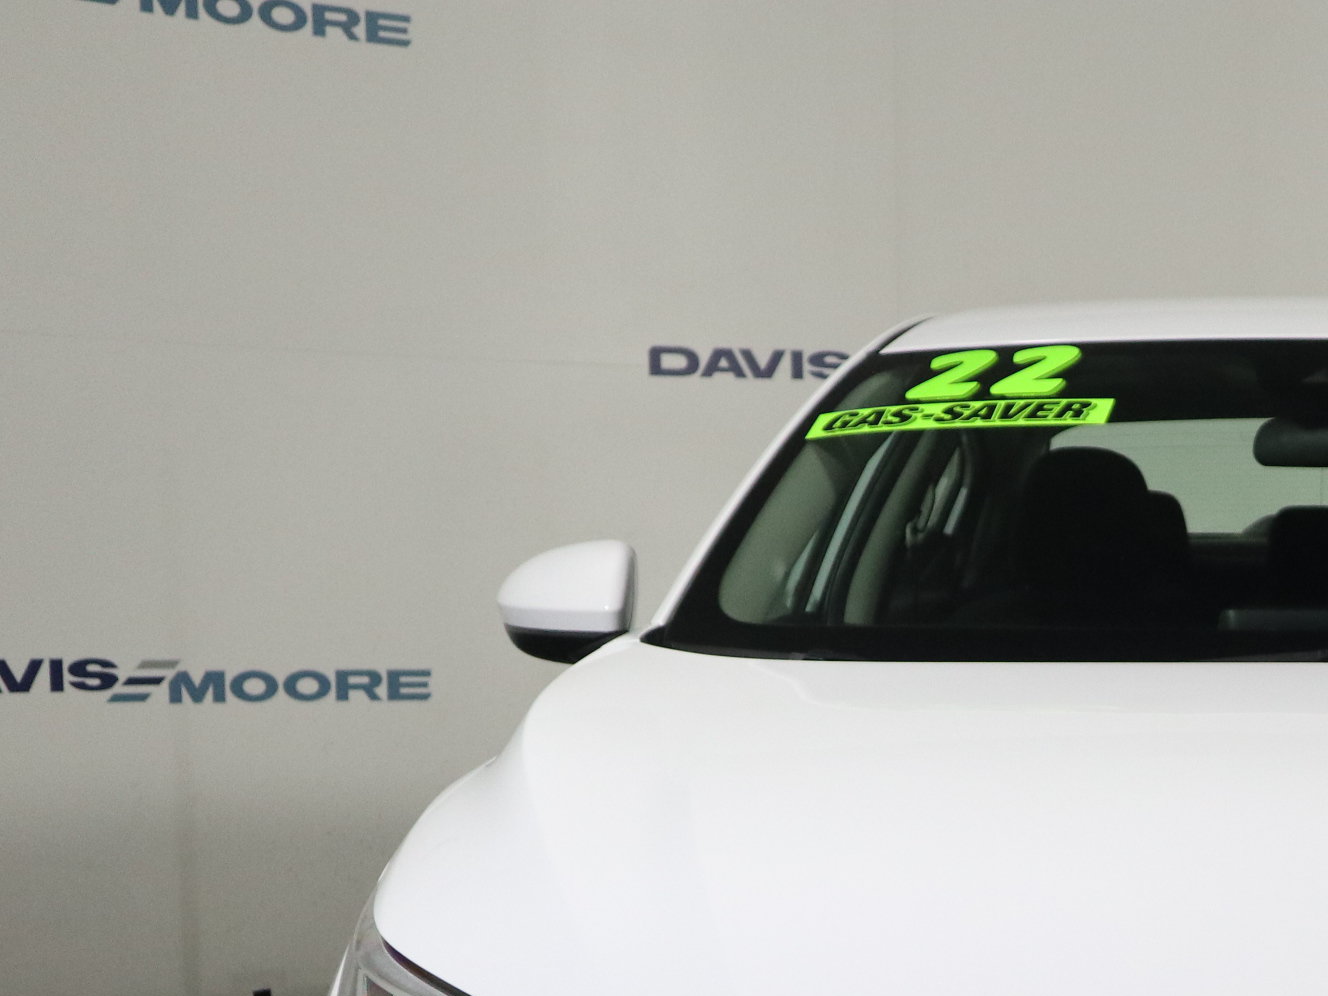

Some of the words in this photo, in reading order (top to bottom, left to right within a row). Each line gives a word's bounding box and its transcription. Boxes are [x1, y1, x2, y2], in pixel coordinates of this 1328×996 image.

[649, 345, 849, 380] DAVIS
[905, 345, 1083, 400] 22
[822, 400, 1096, 432] GAS-SAVER
[0, 658, 119, 693] VIS
[168, 669, 431, 703] MOORE
